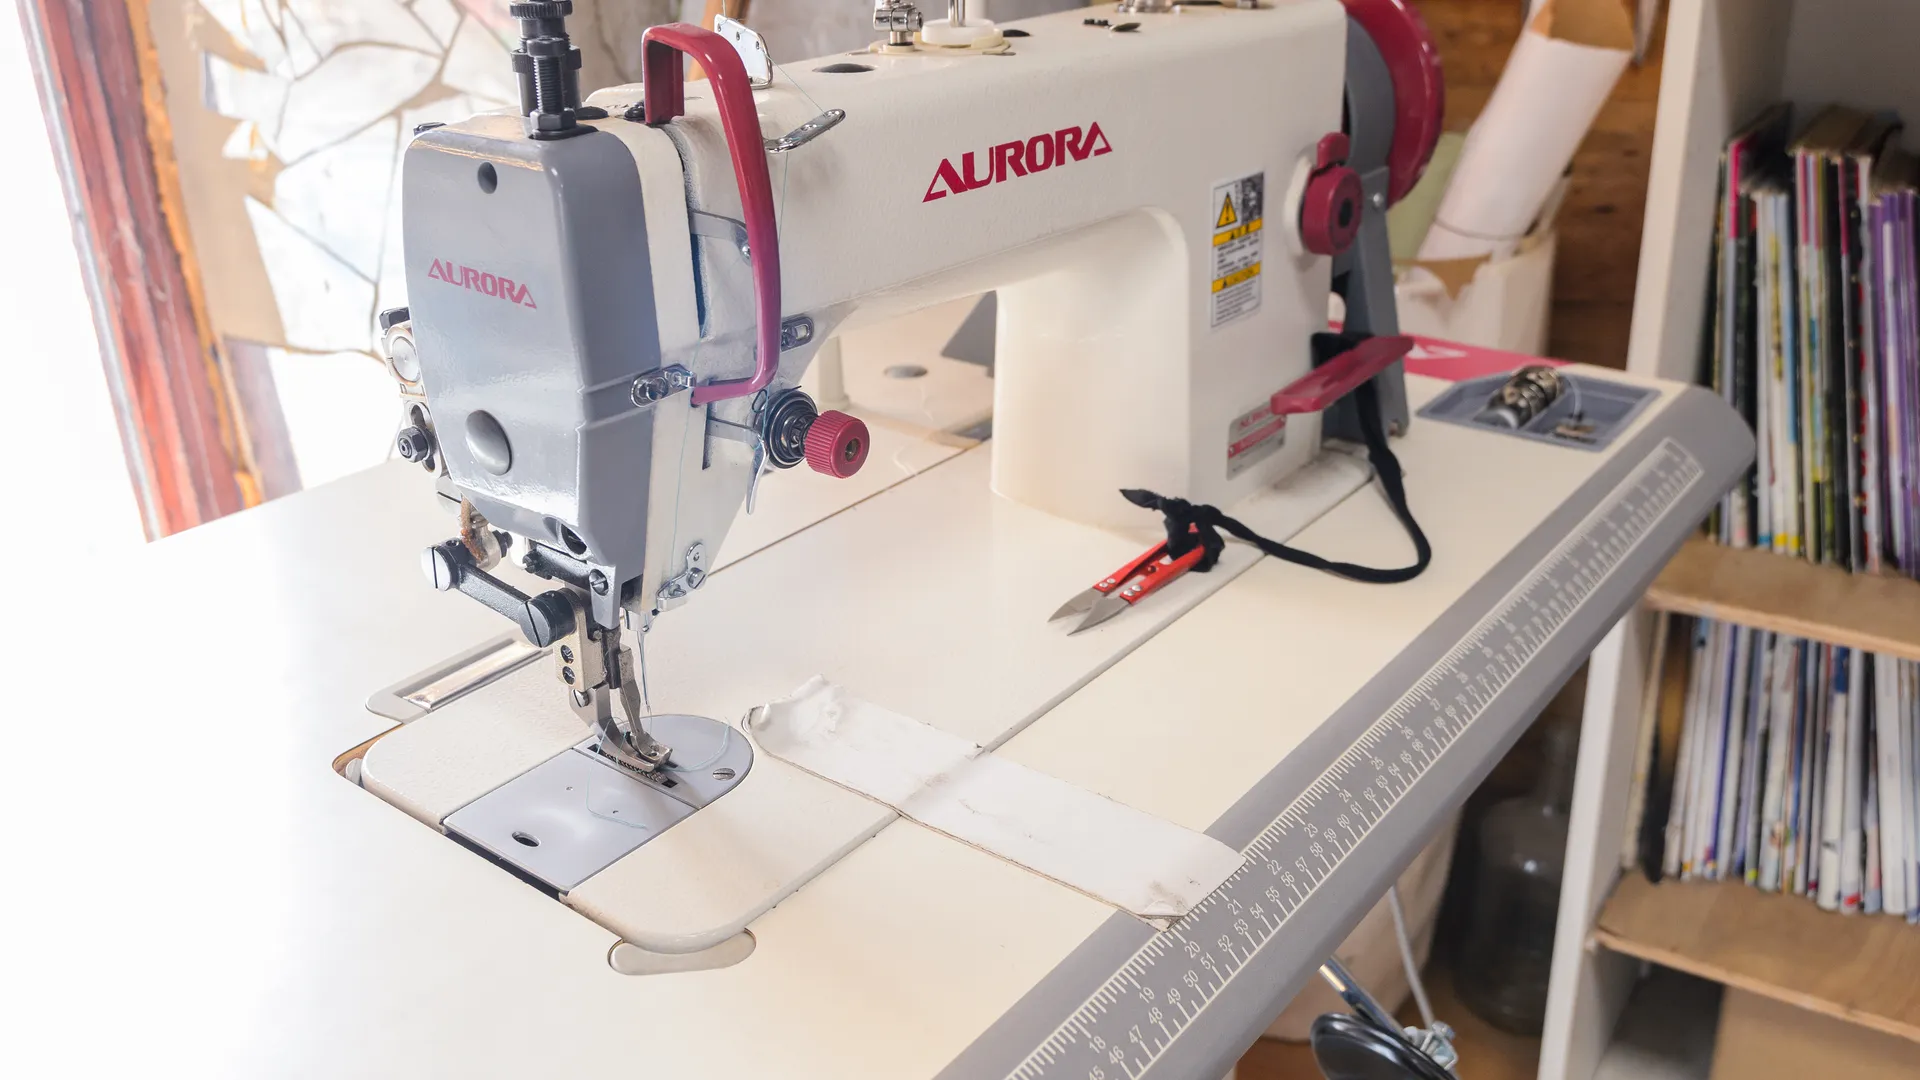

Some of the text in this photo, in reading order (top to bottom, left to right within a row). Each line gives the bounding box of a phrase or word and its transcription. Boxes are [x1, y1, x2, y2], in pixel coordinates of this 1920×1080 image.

[922, 121, 1113, 203] AURORA
[427, 258, 537, 309] AURORA
[1089, 1036, 1106, 1054] 18
[1139, 986, 1155, 1004] 19
[1184, 941, 1200, 958] 20
[1227, 899, 1242, 915] 21
[1266, 860, 1282, 875] 22
[1303, 823, 1318, 838] 23
[1338, 789, 1352, 803] 24
[1371, 757, 1384, 770] 25
[1401, 726, 1414, 739] 26
[1108, 1045, 1124, 1064] 46
[1128, 1025, 1144, 1044] 47
[1148, 1007, 1163, 1026] 48
[1166, 987, 1181, 1005] 49
[1183, 970, 1198, 987] 50
[1200, 952, 1215, 969] 51
[1217, 935, 1232, 951] 52
[1233, 918, 1249, 935] 53
[1249, 903, 1264, 919] 54
[1265, 886, 1280, 902] 55
[1280, 871, 1295, 887] 56
[1295, 856, 1308, 872] 57
[1309, 842, 1323, 857] 58
[1323, 828, 1337, 842] 59
[1337, 814, 1349, 828] 60
[1350, 801, 1362, 814] 61
[1363, 787, 1376, 801] 62
[1375, 775, 1388, 788] 63
[1388, 763, 1399, 776] 64
[1400, 750, 1412, 763] 65
[1411, 739, 1423, 752] 66
[1422, 727, 1433, 739] 67
[1434, 716, 1445, 728] 68
[1444, 705, 1456, 717] 69
